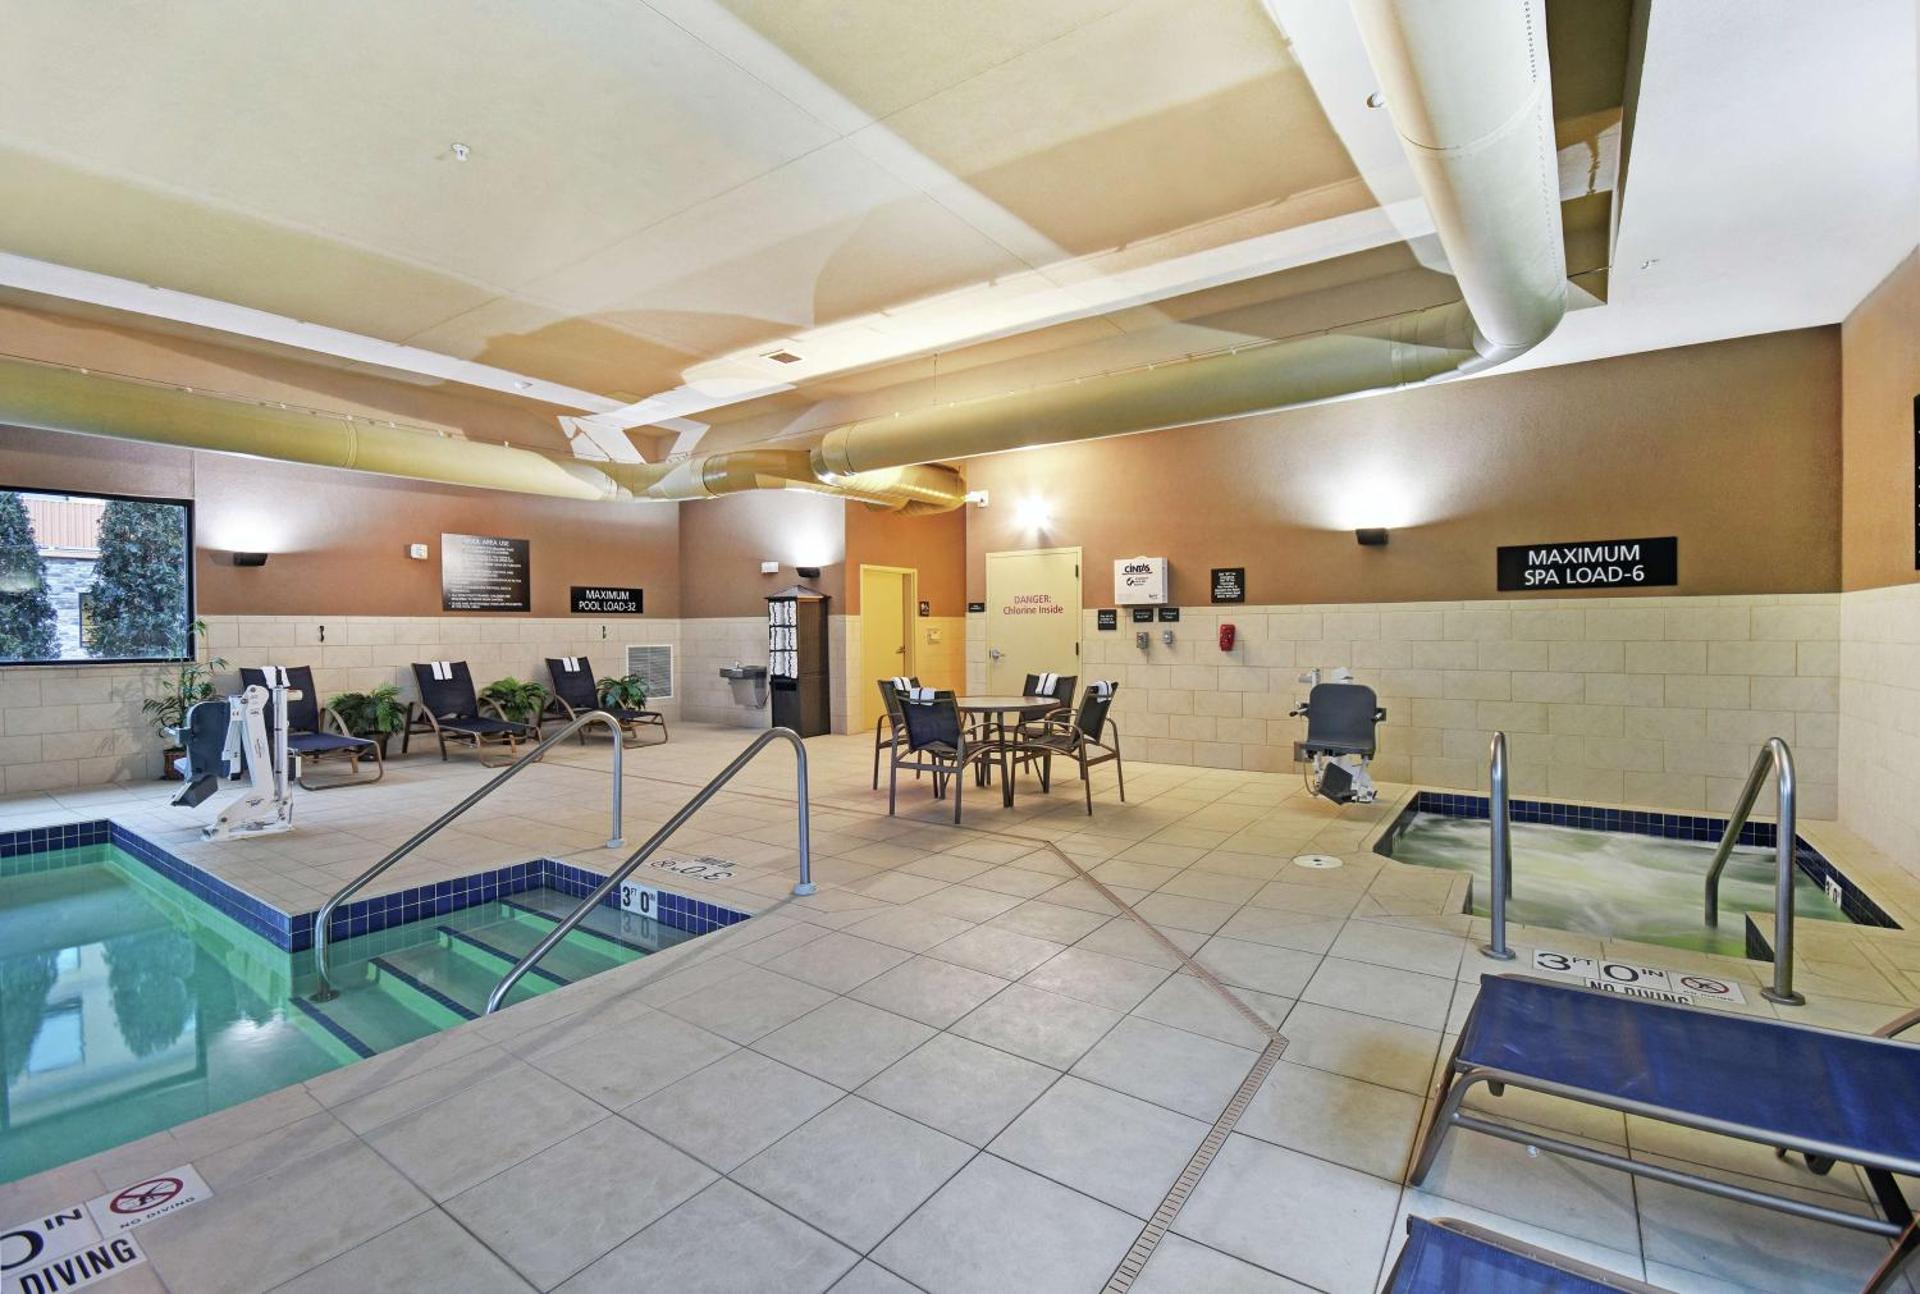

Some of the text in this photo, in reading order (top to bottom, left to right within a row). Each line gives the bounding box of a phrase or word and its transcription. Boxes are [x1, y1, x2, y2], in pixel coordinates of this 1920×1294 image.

[1528, 544, 1640, 566] MAXIMUM
[1524, 565, 1645, 586] SPA LOAD-6
[585, 590, 630, 600] MAXIMUM
[1014, 595, 1052, 604] DANGER:
[579, 601, 637, 611] POOL LOAD-32
[1003, 605, 1064, 615] Chlorine Inside
[119, 1196, 196, 1230] NO DIVING
[19, 1239, 137, 1294] DIVING
